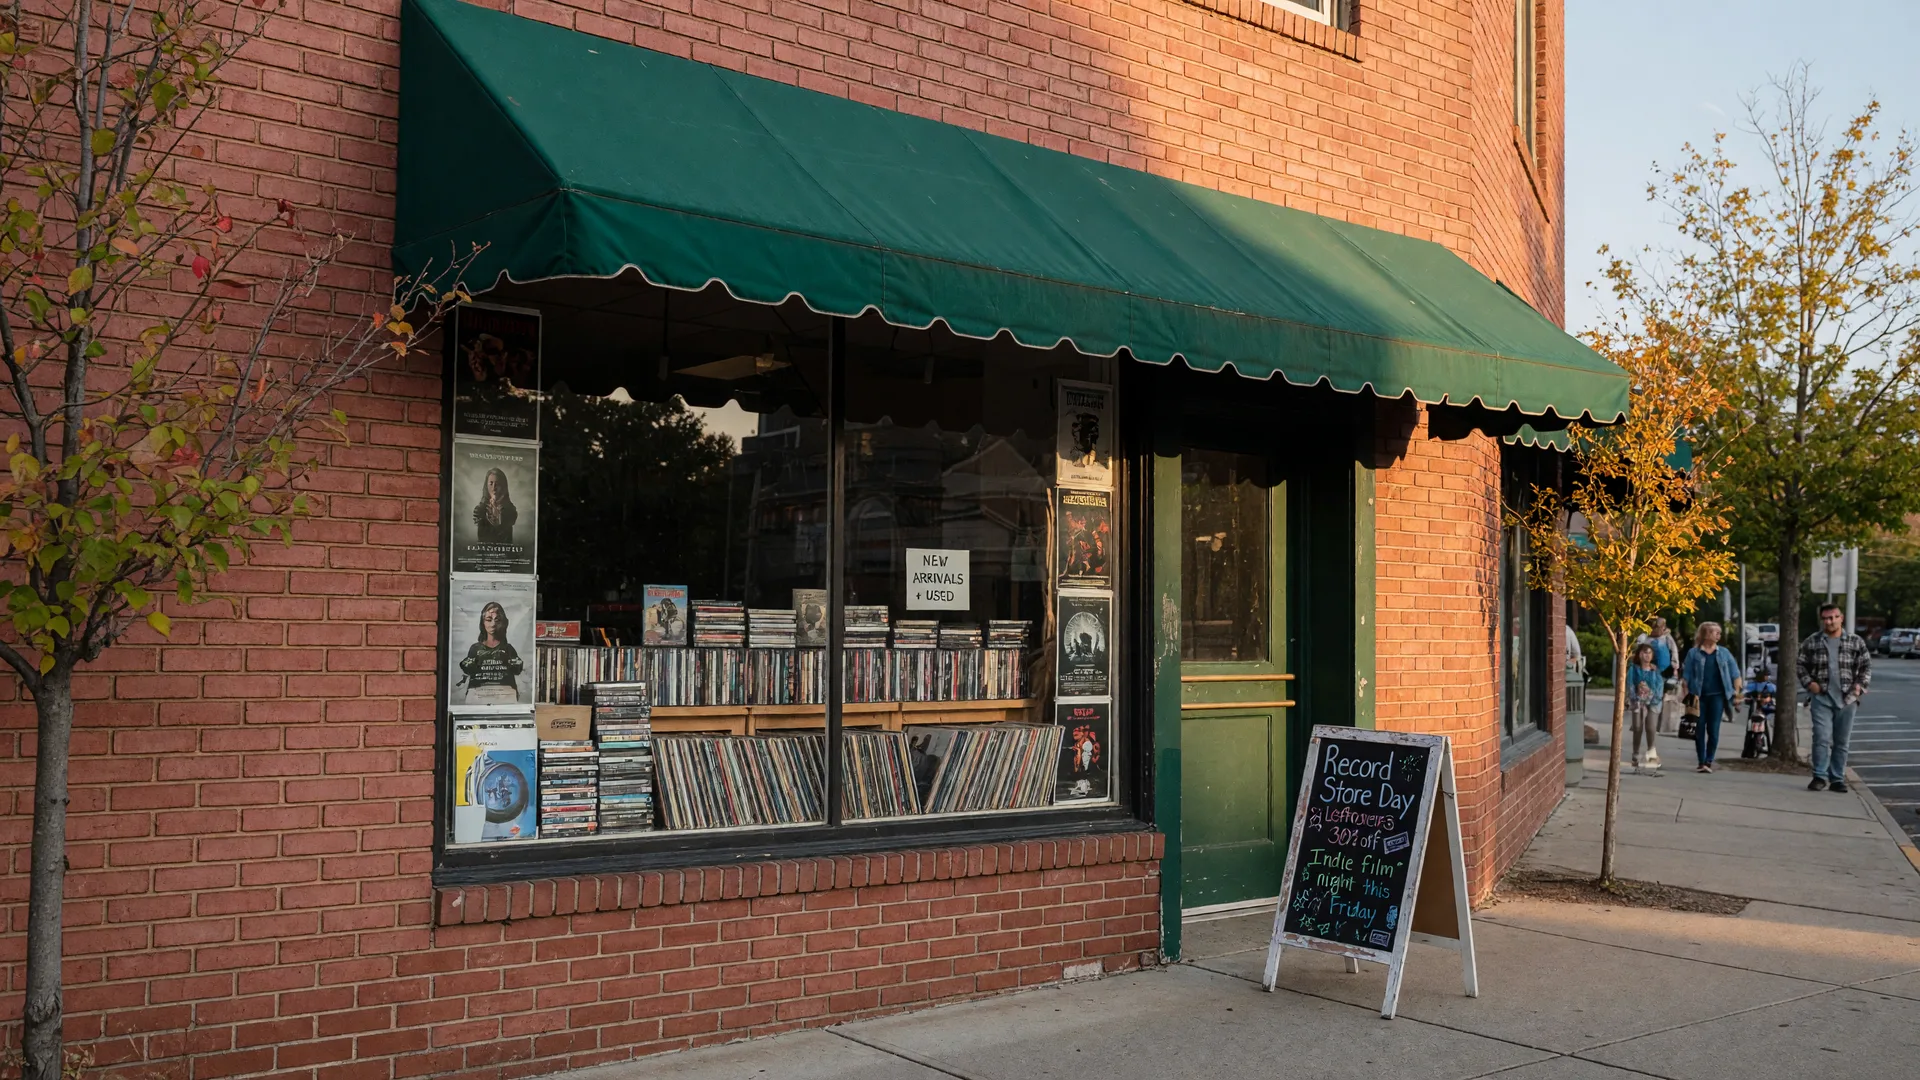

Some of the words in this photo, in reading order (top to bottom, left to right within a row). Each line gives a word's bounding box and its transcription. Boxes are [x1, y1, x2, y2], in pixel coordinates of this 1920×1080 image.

[923, 554, 949, 567] NEW
[912, 572, 964, 585] ARRIVALS
[926, 590, 955, 602] USED
[1323, 743, 1394, 781] Record
[1319, 776, 1373, 806] Store
[1378, 782, 1416, 820] Day
[1360, 829, 1382, 851] off
[1308, 848, 1354, 871] Indie
[1361, 854, 1394, 879] film
[1316, 872, 1356, 896] night
[1362, 878, 1390, 899] this
[1329, 895, 1377, 929] Friday
